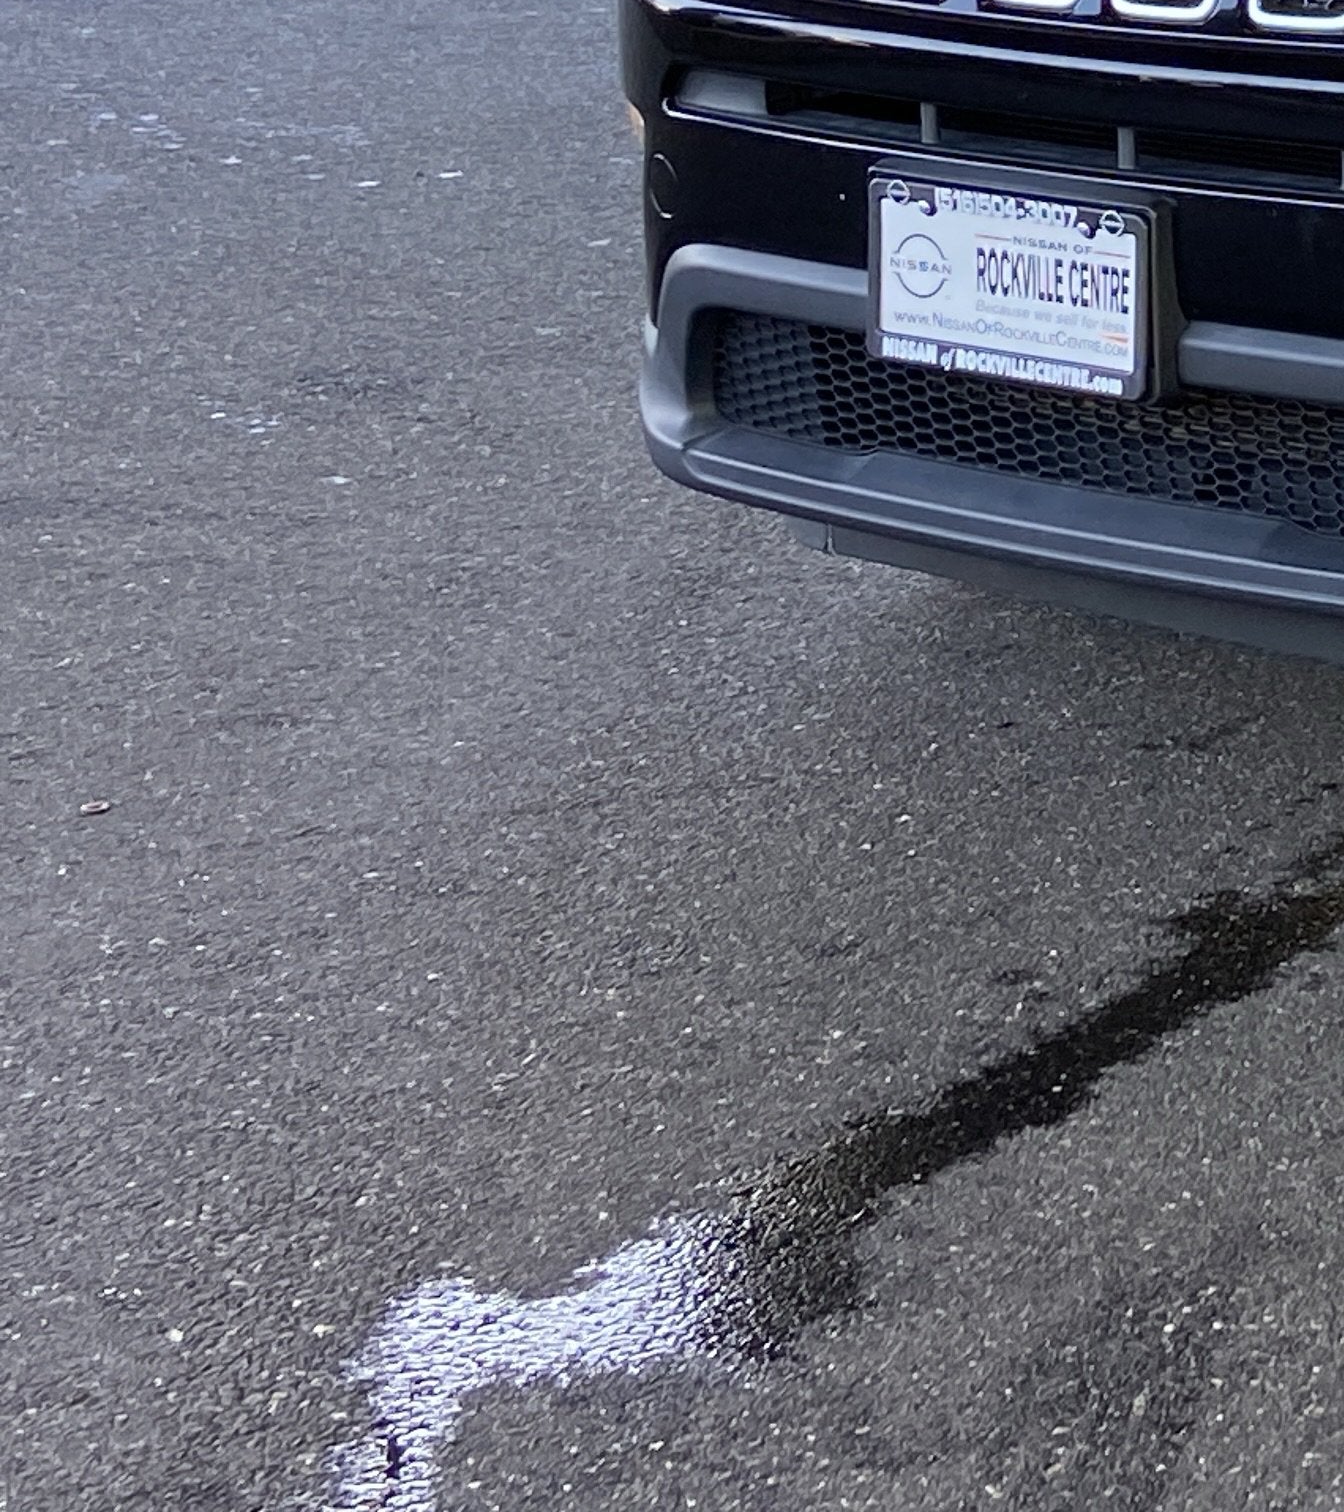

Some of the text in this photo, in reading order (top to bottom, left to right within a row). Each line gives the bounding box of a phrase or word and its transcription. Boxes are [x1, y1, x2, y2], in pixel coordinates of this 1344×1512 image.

[1012, 236, 1094, 256] NISSAN OF
[889, 256, 952, 275] NISSAN
[975, 247, 1130, 315] ROCKVILLE CENTRE
[975, 299, 1030, 319] Because
[1034, 309, 1052, 323] we
[1056, 311, 1078, 326] sell
[882, 335, 938, 365] NISSAN
